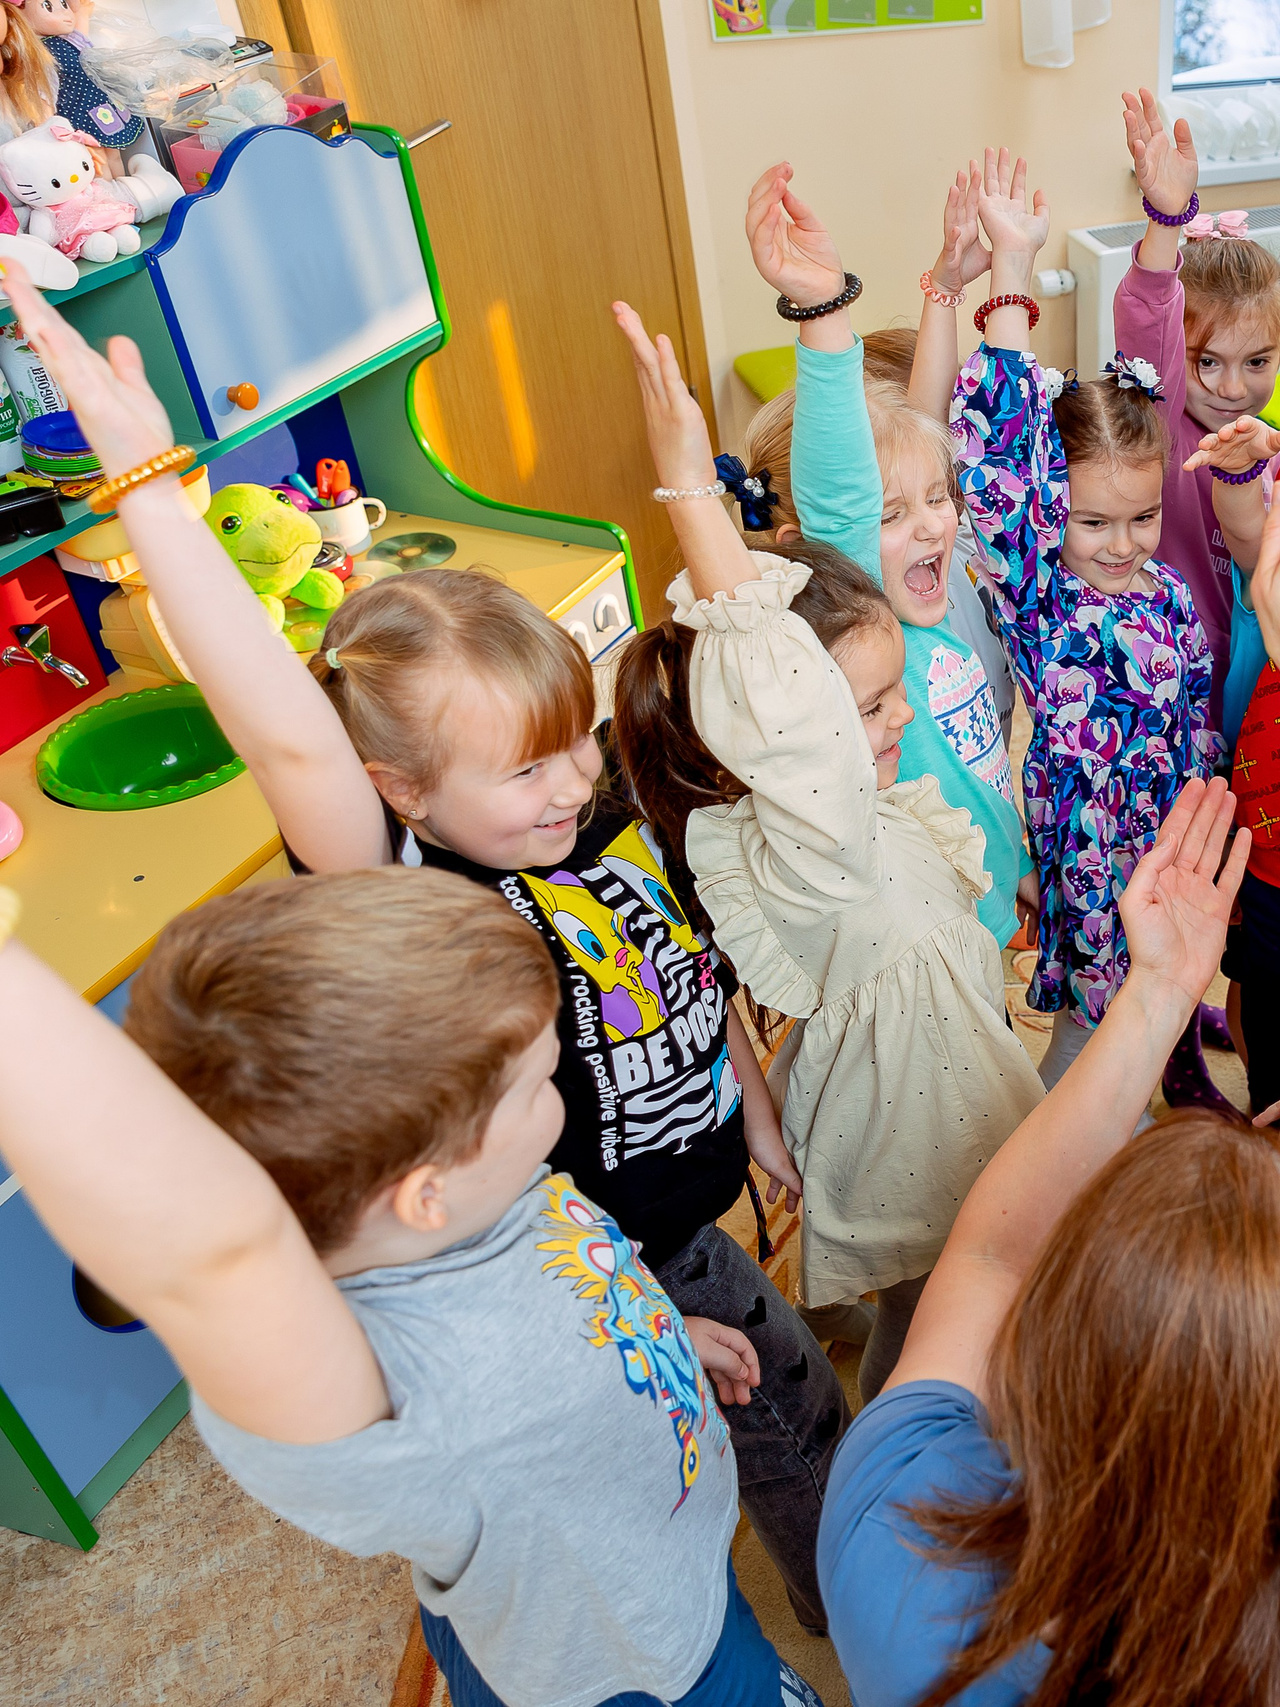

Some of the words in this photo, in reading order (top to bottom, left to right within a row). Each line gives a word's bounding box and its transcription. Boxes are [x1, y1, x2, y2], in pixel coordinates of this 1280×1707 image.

[570, 975, 599, 1048] rocking
[611, 1030, 674, 1095] BE
[670, 984, 728, 1067] POSI
[585, 1053, 620, 1121] positive
[601, 1127, 622, 1171] vibes
